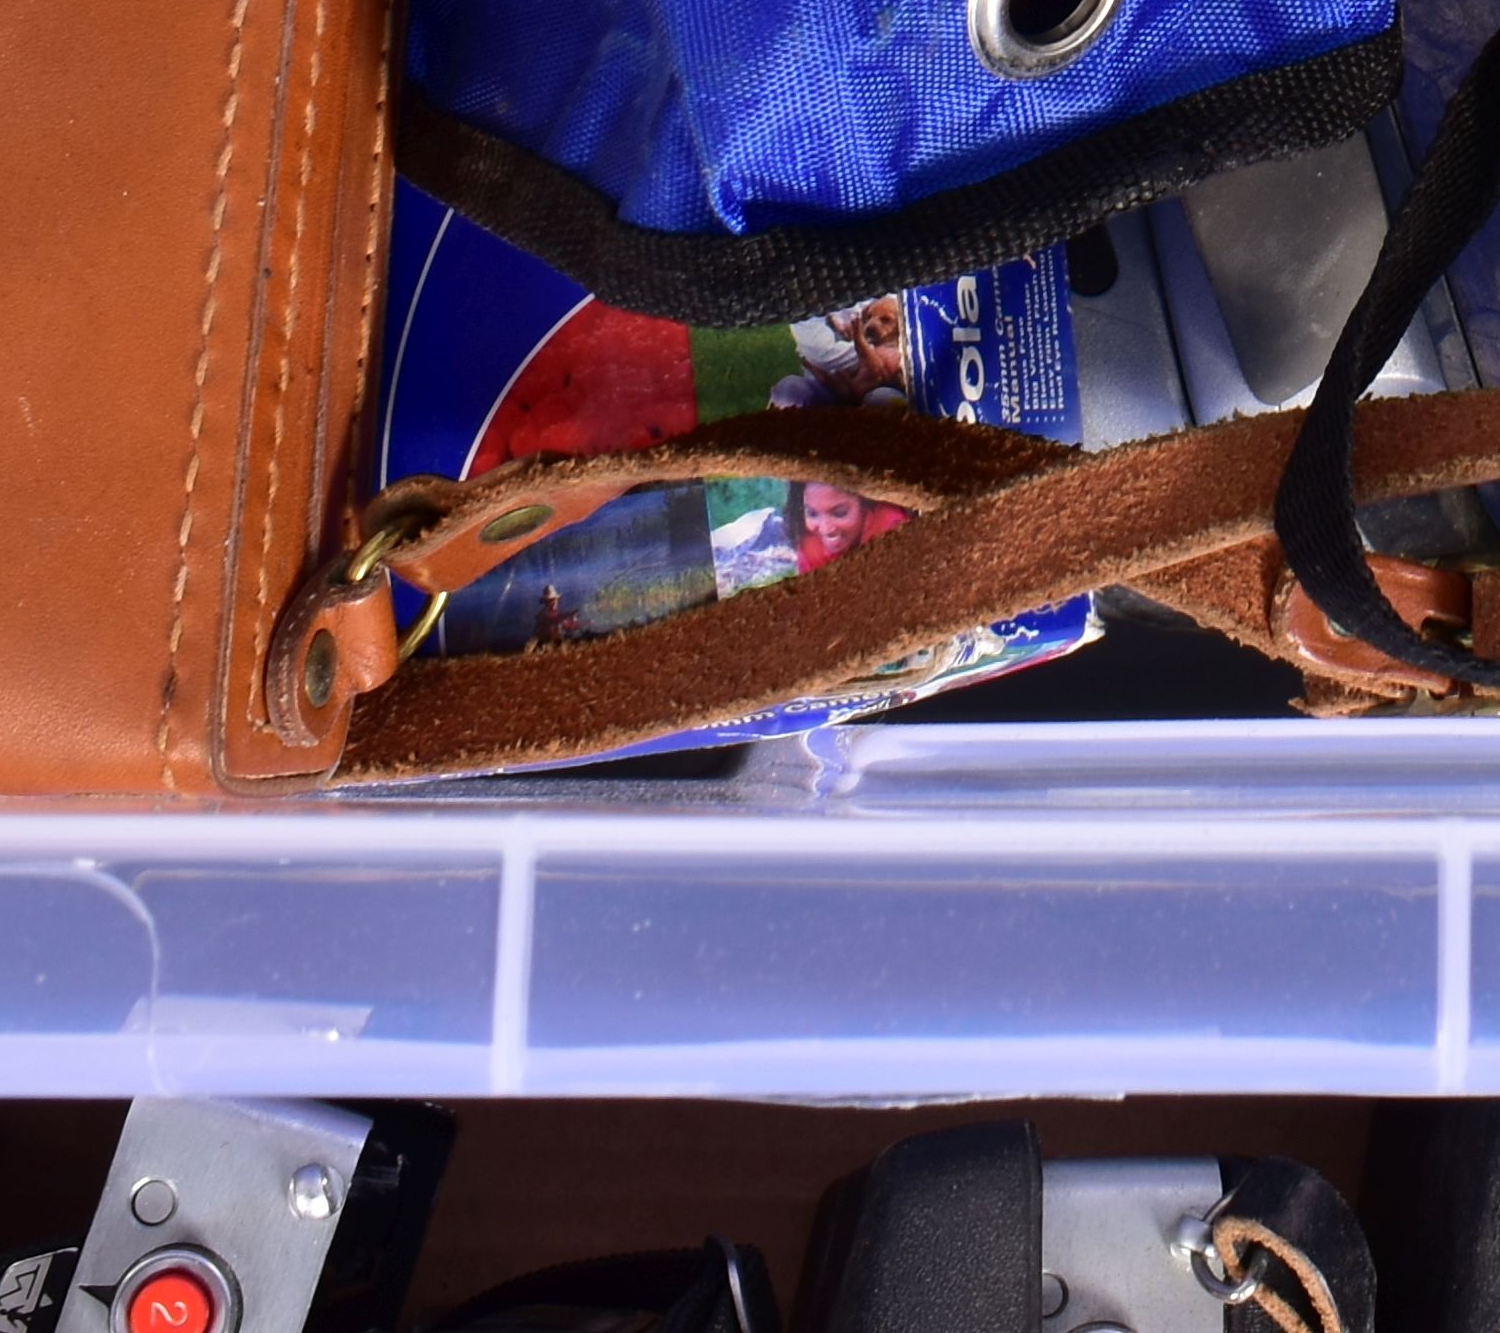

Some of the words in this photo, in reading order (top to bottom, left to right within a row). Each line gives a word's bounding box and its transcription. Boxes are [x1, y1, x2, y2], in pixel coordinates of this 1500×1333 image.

[992, 264, 1005, 335] Came
[1031, 273, 1041, 319] Flash
[1039, 253, 1051, 322] Loading
[1047, 249, 1060, 335] Reduction
[1017, 317, 1027, 354] Free
[1024, 283, 1036, 376] Viewfinder
[1043, 327, 1053, 364] Film
[1004, 315, 1021, 423] Manual
[1035, 324, 1048, 410] Electronic
[1053, 339, 1062, 371] Eye
[1021, 359, 1031, 410] Focus
[1031, 381, 1039, 410] Big
[1046, 368, 1057, 410] Easy
[1055, 375, 1065, 410] Red
[151, 1300, 189, 1328] 2
